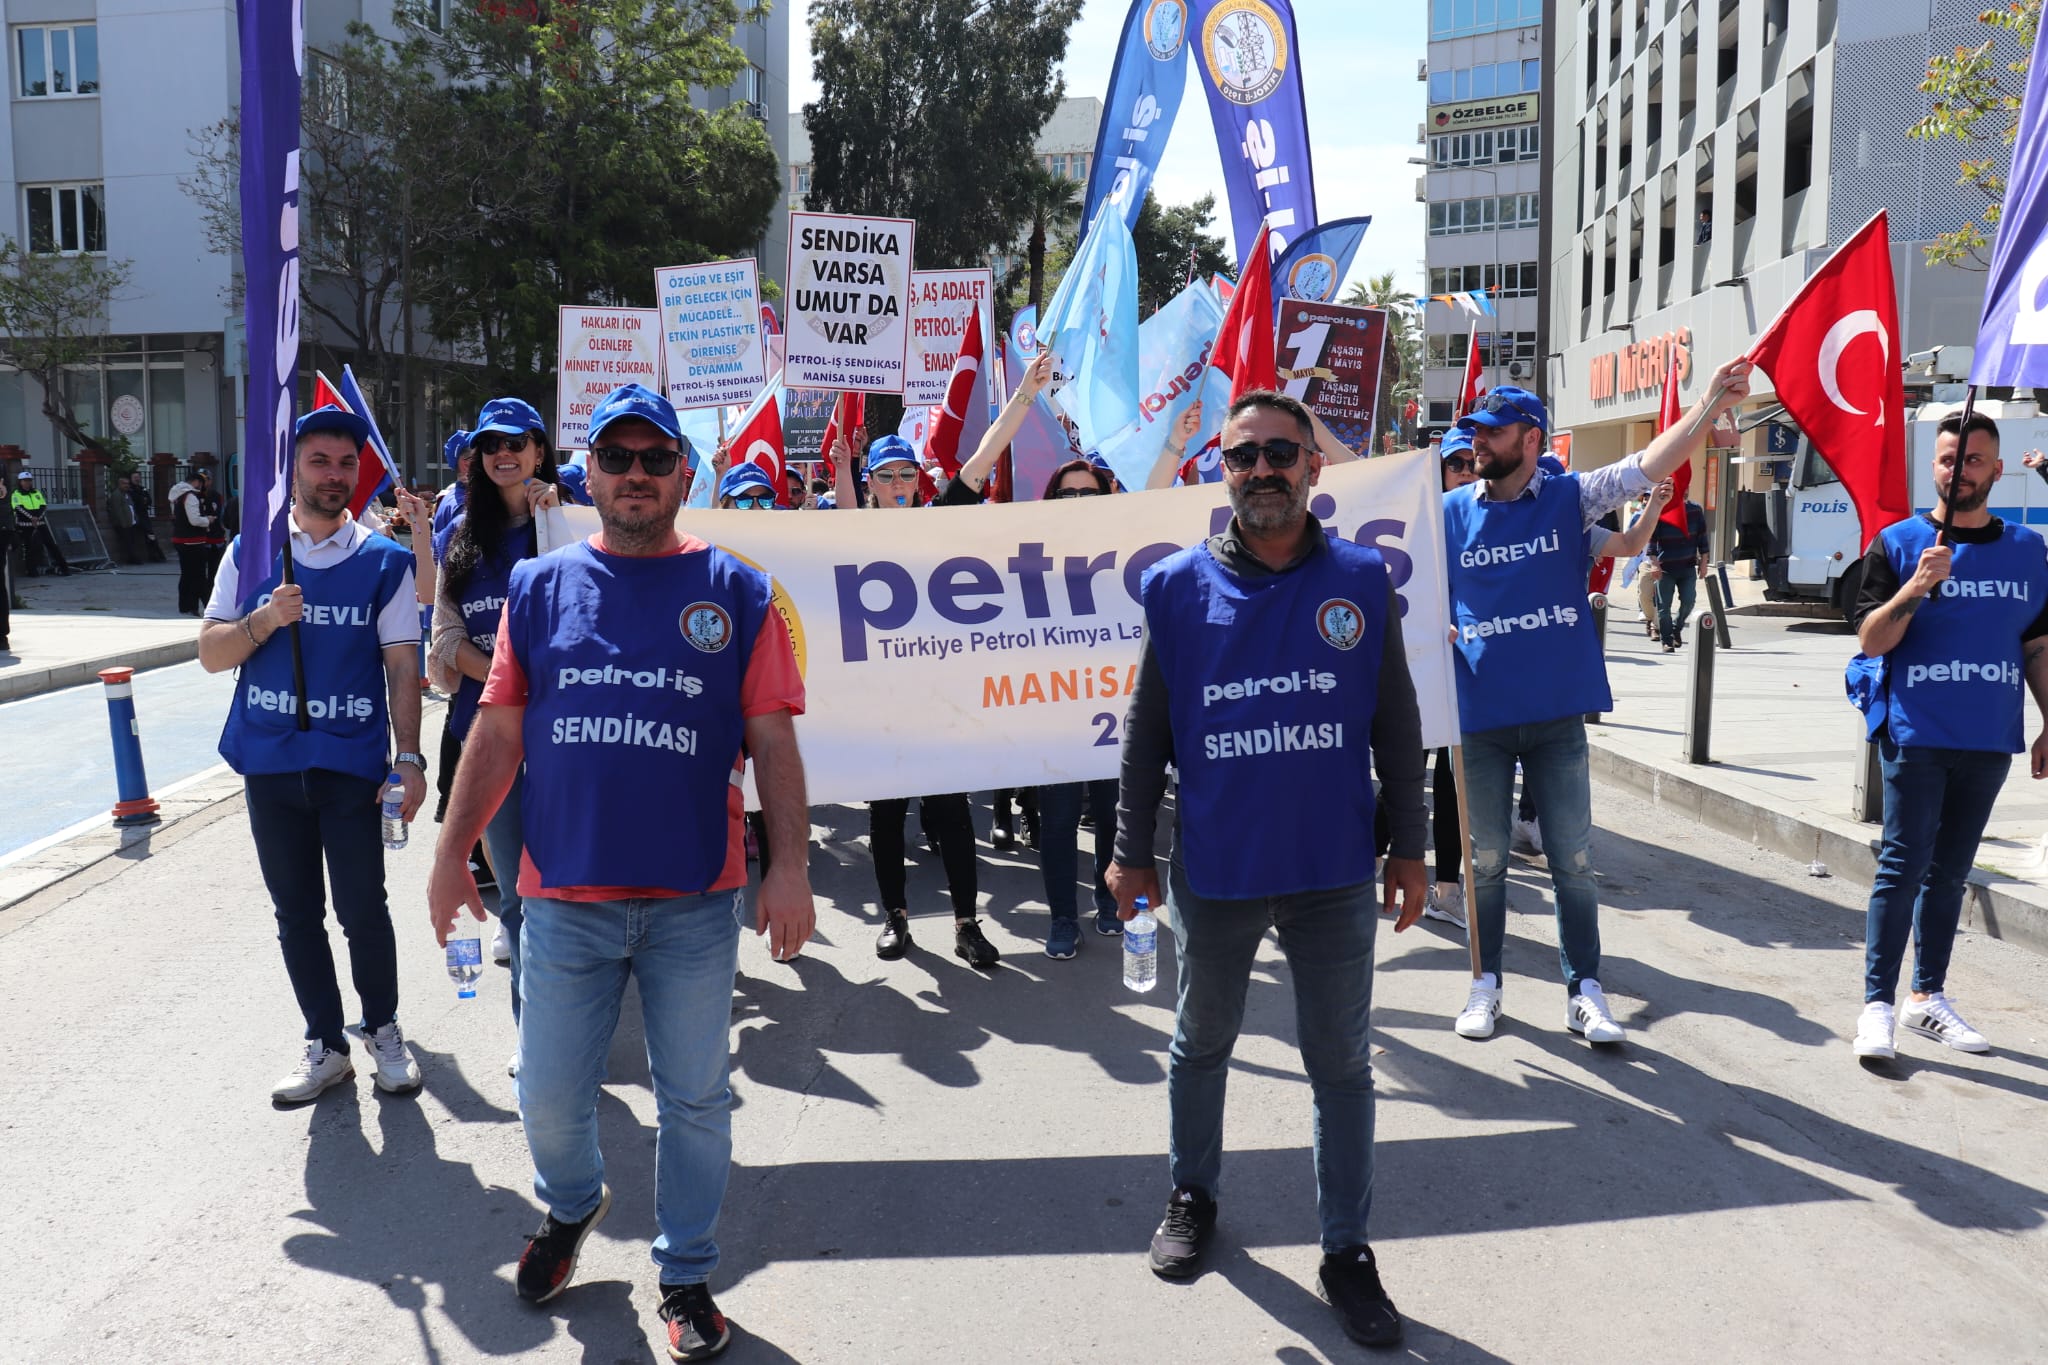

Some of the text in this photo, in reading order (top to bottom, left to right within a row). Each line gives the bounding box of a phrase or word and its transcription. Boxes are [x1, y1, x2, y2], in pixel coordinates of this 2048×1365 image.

[1452, 102, 1528, 119] ÖZBELGE
[800, 225, 900, 256] SENDİKA
[669, 269, 744, 288] ÖZGÜR VE EŞİT
[812, 259, 885, 285] VARSA
[665, 286, 752, 307] BİR GELECEK İÇİN
[796, 289, 899, 317] UMUT DA
[923, 281, 938, 307] AŞ
[941, 280, 985, 301] ADALET
[581, 314, 641, 330] HAKLARI İÇİN
[669, 327, 699, 342] ETKİN
[823, 321, 868, 345] VAR
[588, 335, 633, 352] ÖLENLERE
[565, 356, 600, 373] MİNNET
[602, 361, 613, 373] VE
[689, 361, 743, 377] DEVAMMM
[788, 354, 901, 370] PETROL-İŞ SENDİKASI
[924, 352, 959, 372] EMAN
[1334, 359, 1362, 370] MAYIS
[803, 369, 885, 386] MANİSA ŞUBESİ
[1292, 366, 1316, 379] MAYIS
[585, 382, 611, 394] AKAN
[671, 375, 763, 391] PETROL-İŞ SENDİKASI
[562, 422, 589, 431] PETRO
[789, 446, 821, 456] petro
[1801, 499, 1848, 513] POLİS
[1460, 529, 1559, 568] GÖREVLİ
[1924, 576, 2028, 602] ÖREVLİ
[462, 595, 506, 619] petr
[1462, 605, 1578, 644] petrol-iş
[878, 634, 963, 660] Türkiye
[970, 629, 1036, 652] Petrol
[1043, 624, 1111, 650] Kimya
[558, 663, 703, 698] petrol-iş
[1907, 659, 2020, 691] petrol-iş
[1203, 668, 1337, 707] petrol-iş
[247, 684, 374, 723] petrol-iş
[551, 712, 697, 756] SENDİKASI
[1204, 721, 1343, 760] SENDİKASI
